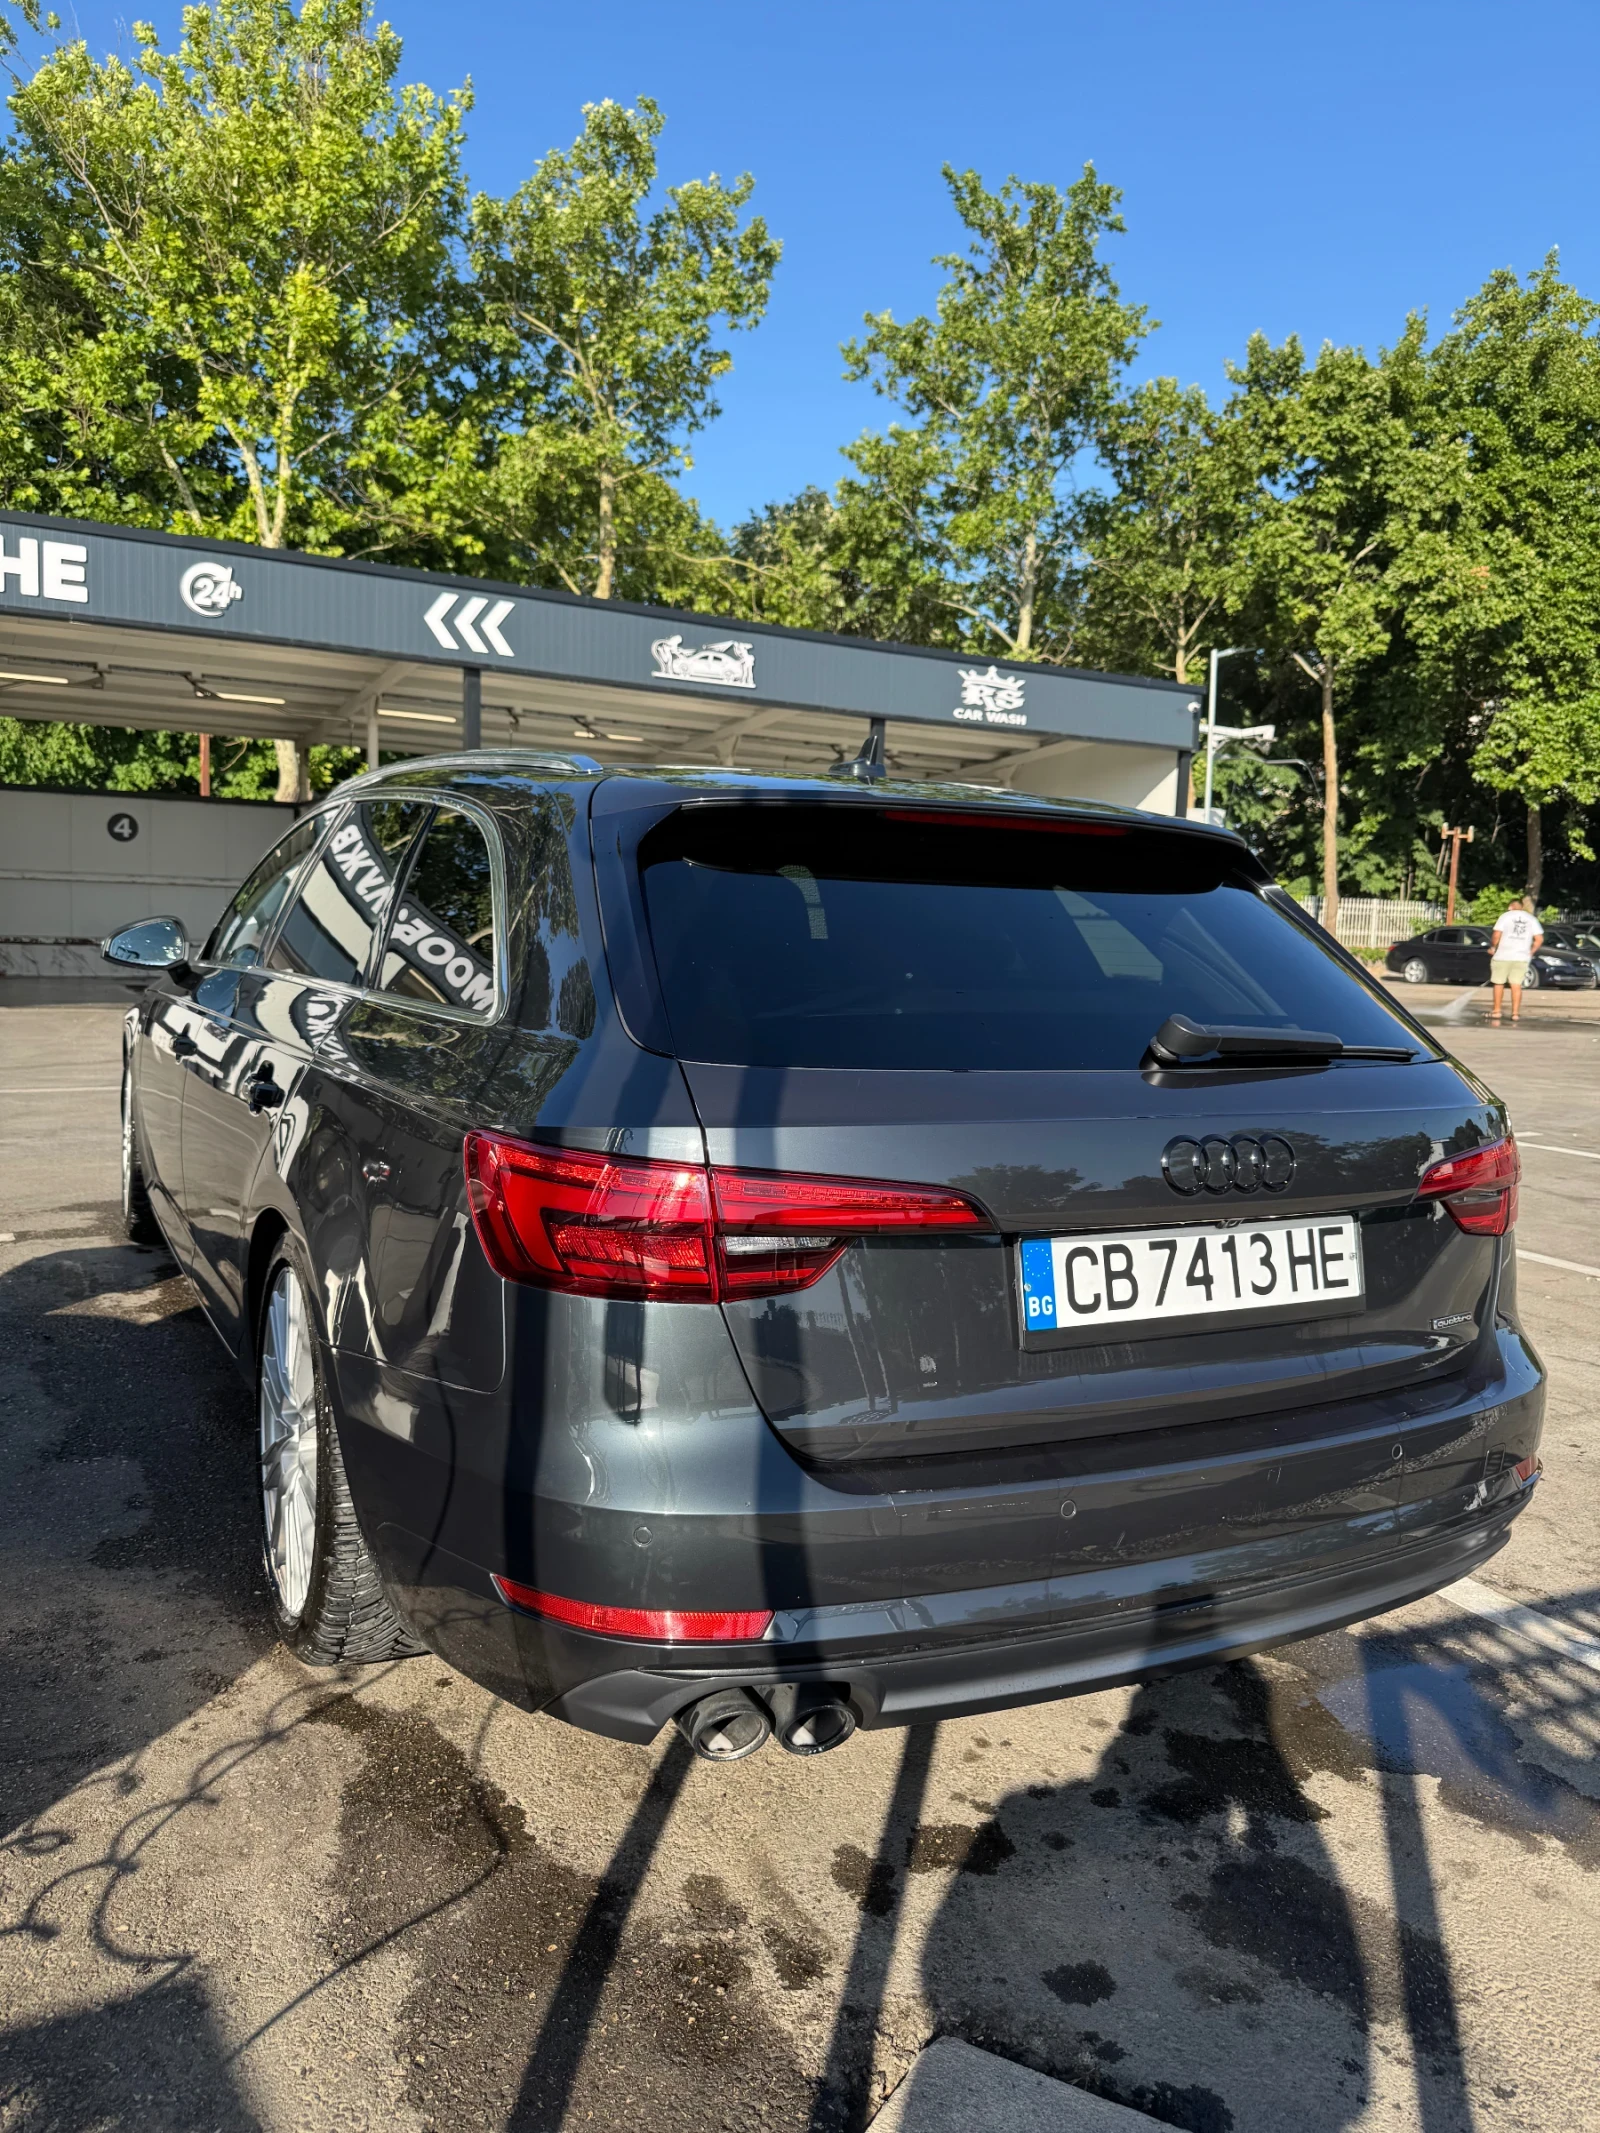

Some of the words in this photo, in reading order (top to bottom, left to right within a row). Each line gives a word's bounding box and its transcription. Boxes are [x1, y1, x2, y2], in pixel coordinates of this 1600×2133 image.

[194, 577, 243, 609] 24h
[961, 684, 1026, 712] RS
[953, 707, 983, 721] CAR
[986, 711, 1027, 726] WASH
[113, 818, 132, 838] 4
[1028, 1296, 1053, 1316] BG
[1437, 1314, 1472, 1328] quattro
